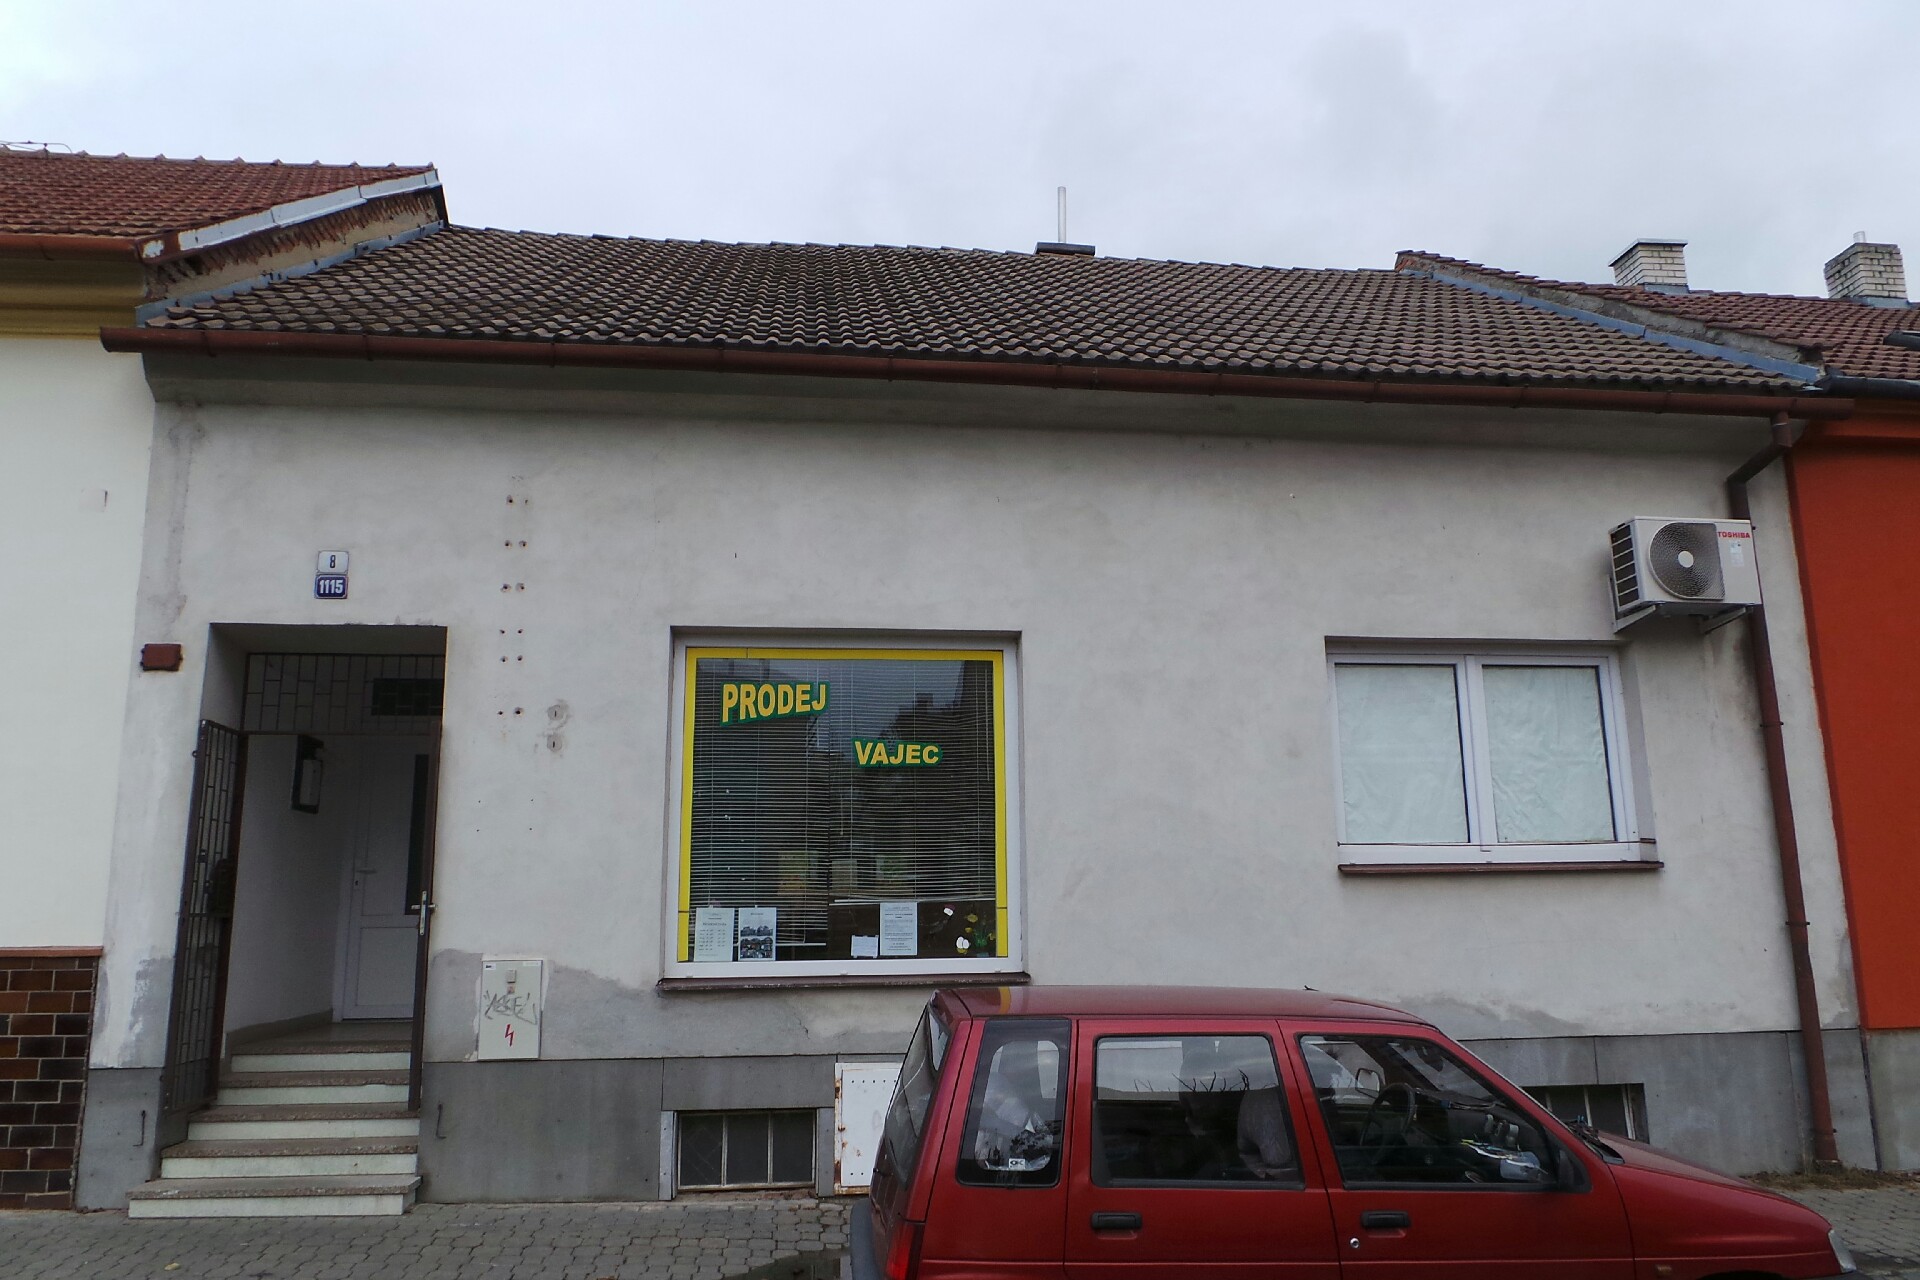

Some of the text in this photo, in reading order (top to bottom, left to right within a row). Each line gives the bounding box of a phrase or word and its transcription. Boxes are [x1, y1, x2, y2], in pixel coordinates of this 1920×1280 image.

[1717, 531, 1751, 539] TOSHIBA
[329, 554, 336, 568] 8
[319, 579, 343, 594] 1115
[722, 683, 826, 723] PRODEJ
[854, 741, 939, 765] VAJEC
